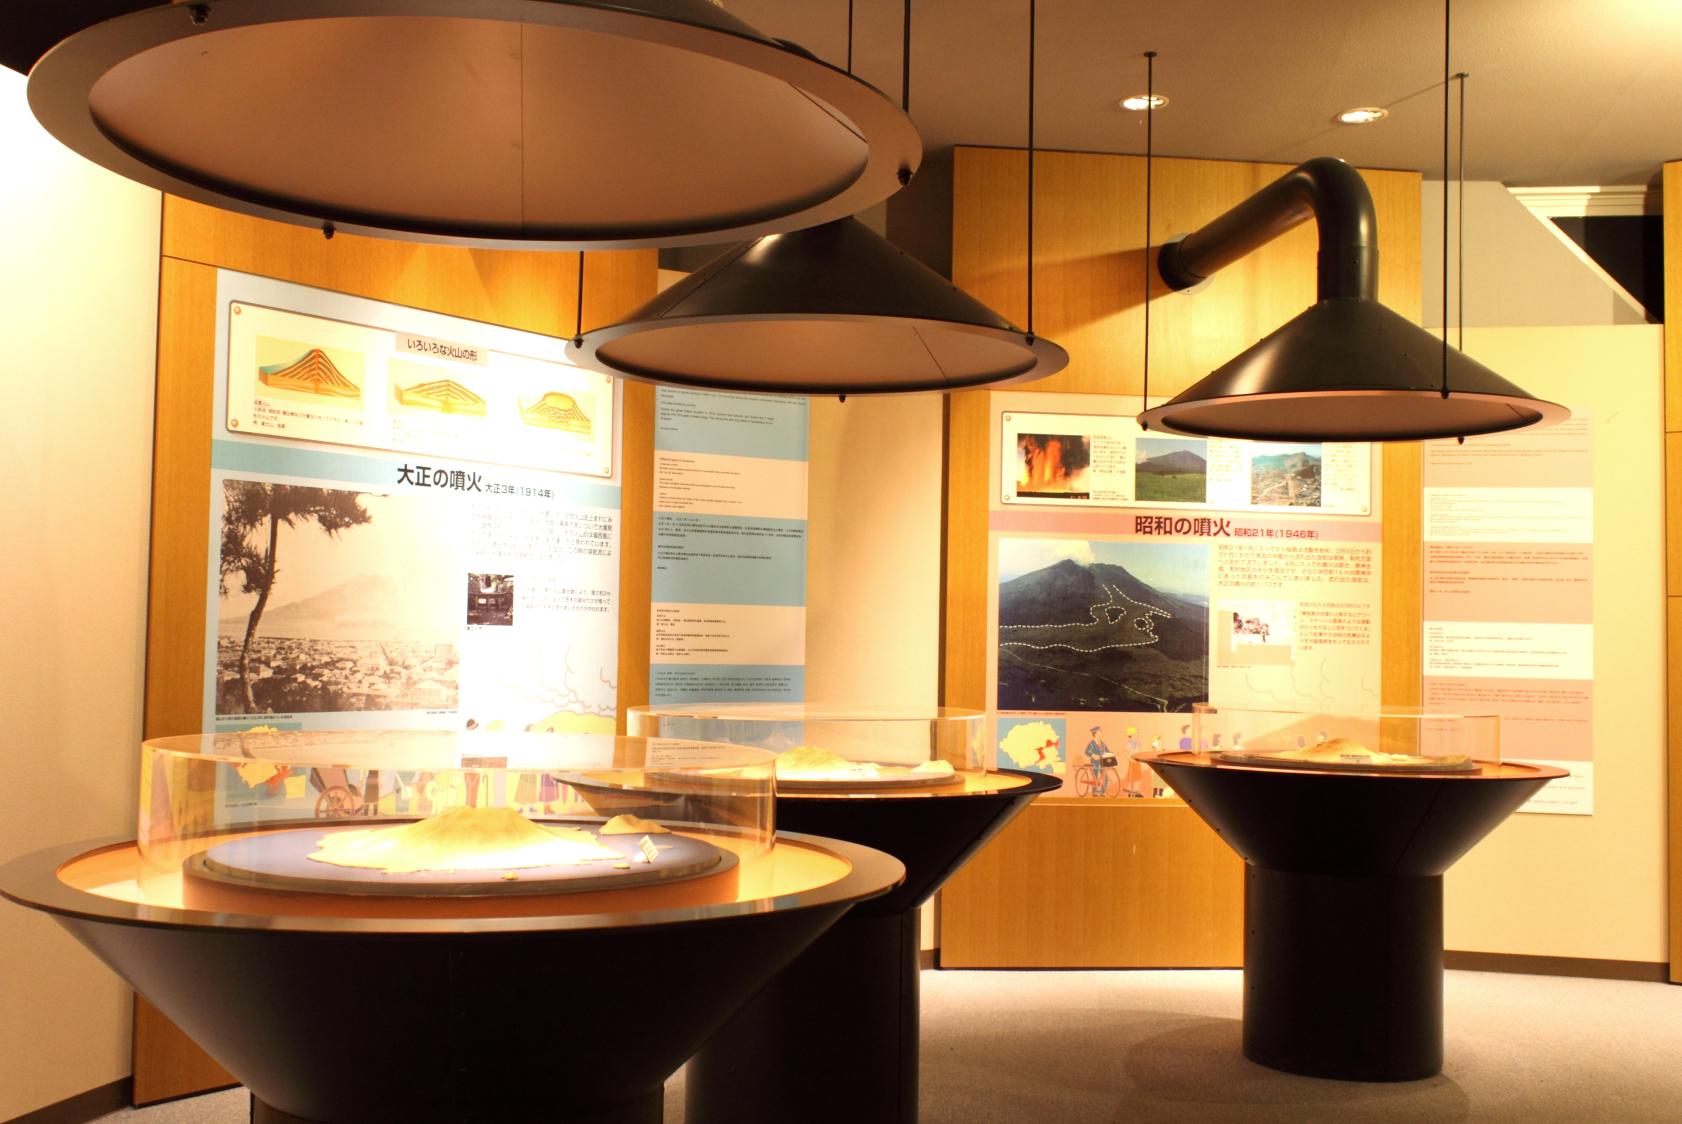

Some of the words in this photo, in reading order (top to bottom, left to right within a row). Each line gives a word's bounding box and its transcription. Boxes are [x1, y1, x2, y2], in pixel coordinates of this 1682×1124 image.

[407, 337, 478, 361] いろいろな火山の形
[397, 463, 482, 493] 大正の噴火
[485, 483, 555, 499] 大正3年(1914年)
[1135, 515, 1231, 537] 昭和の噴火
[1234, 527, 1319, 540] 昭和21年(1946年)
